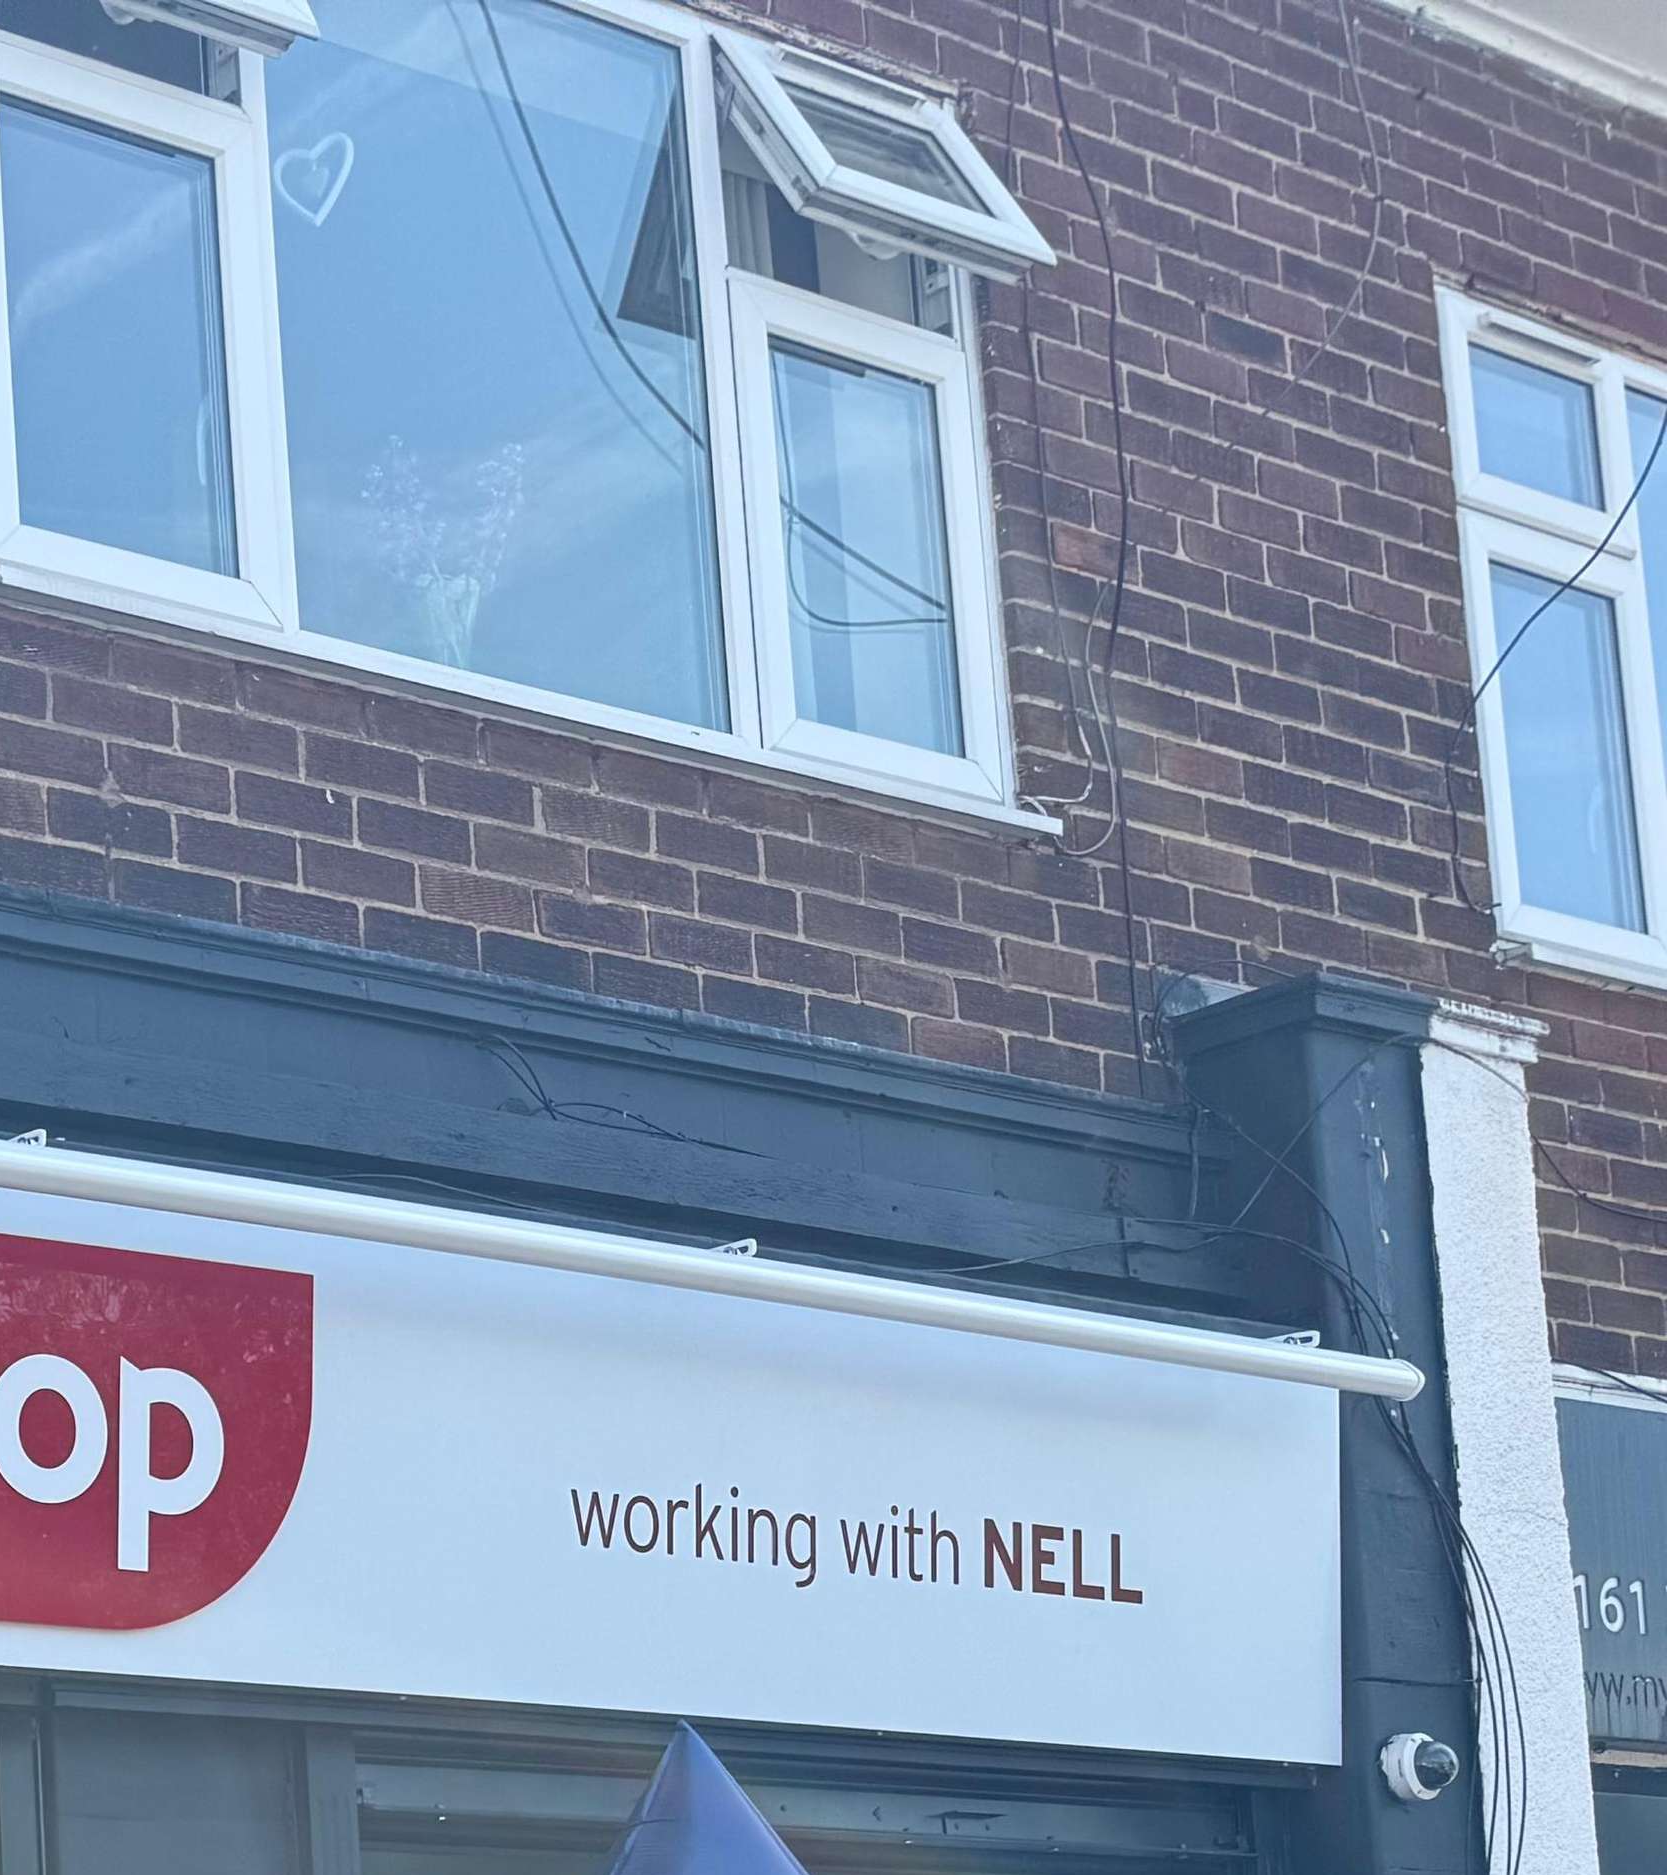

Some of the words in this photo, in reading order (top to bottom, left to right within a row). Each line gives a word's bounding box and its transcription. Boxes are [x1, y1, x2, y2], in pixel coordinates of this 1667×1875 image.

[570, 1483, 817, 1588] working
[840, 1504, 960, 1585] with
[983, 1517, 1144, 1605] NELL
